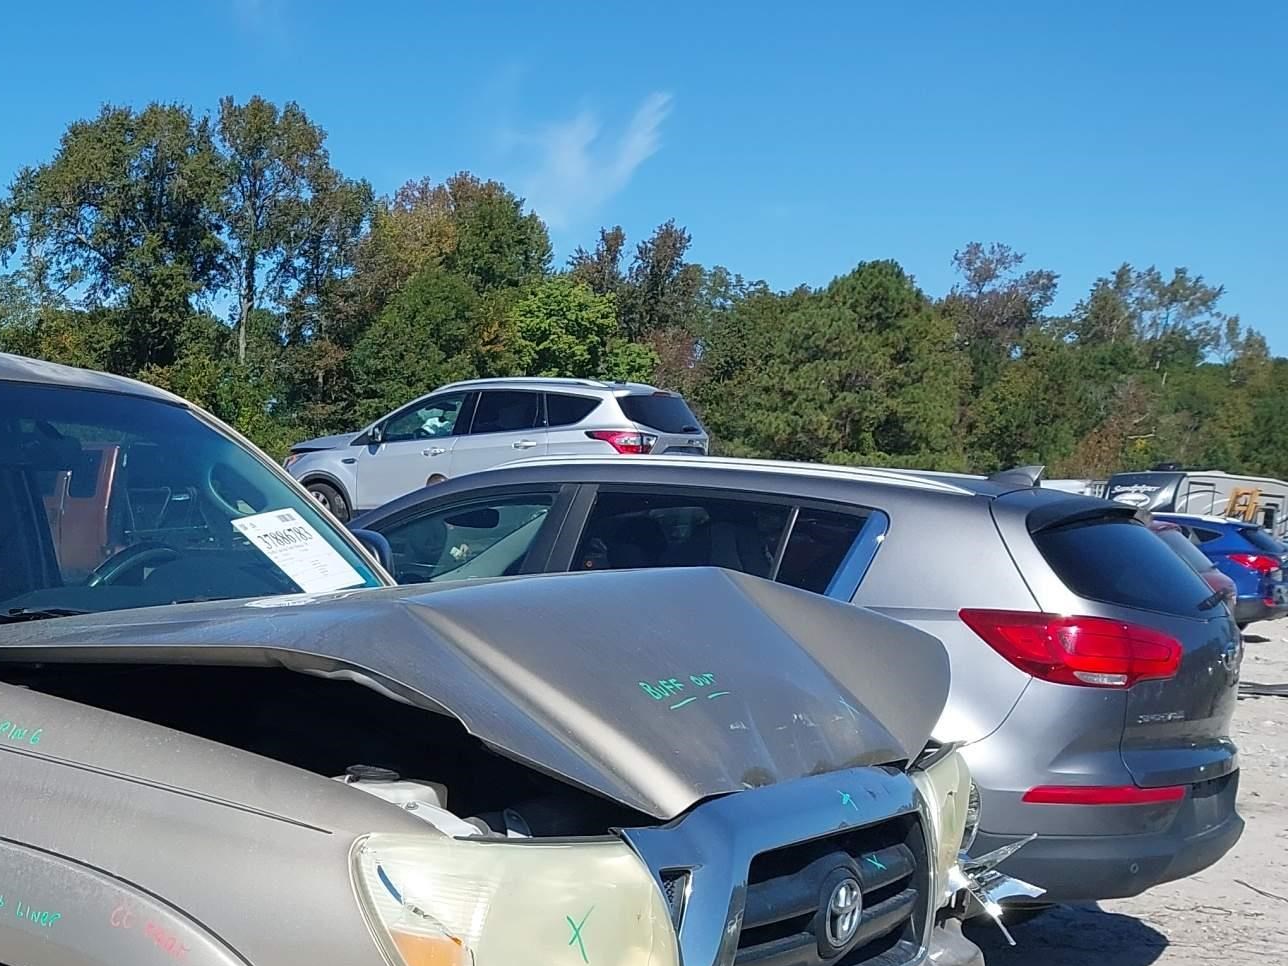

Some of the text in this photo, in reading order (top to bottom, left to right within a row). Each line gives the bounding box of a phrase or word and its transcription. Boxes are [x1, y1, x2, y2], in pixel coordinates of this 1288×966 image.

[257, 525, 314, 549] 37886783
[639, 672, 717, 700] BUFF OUT
